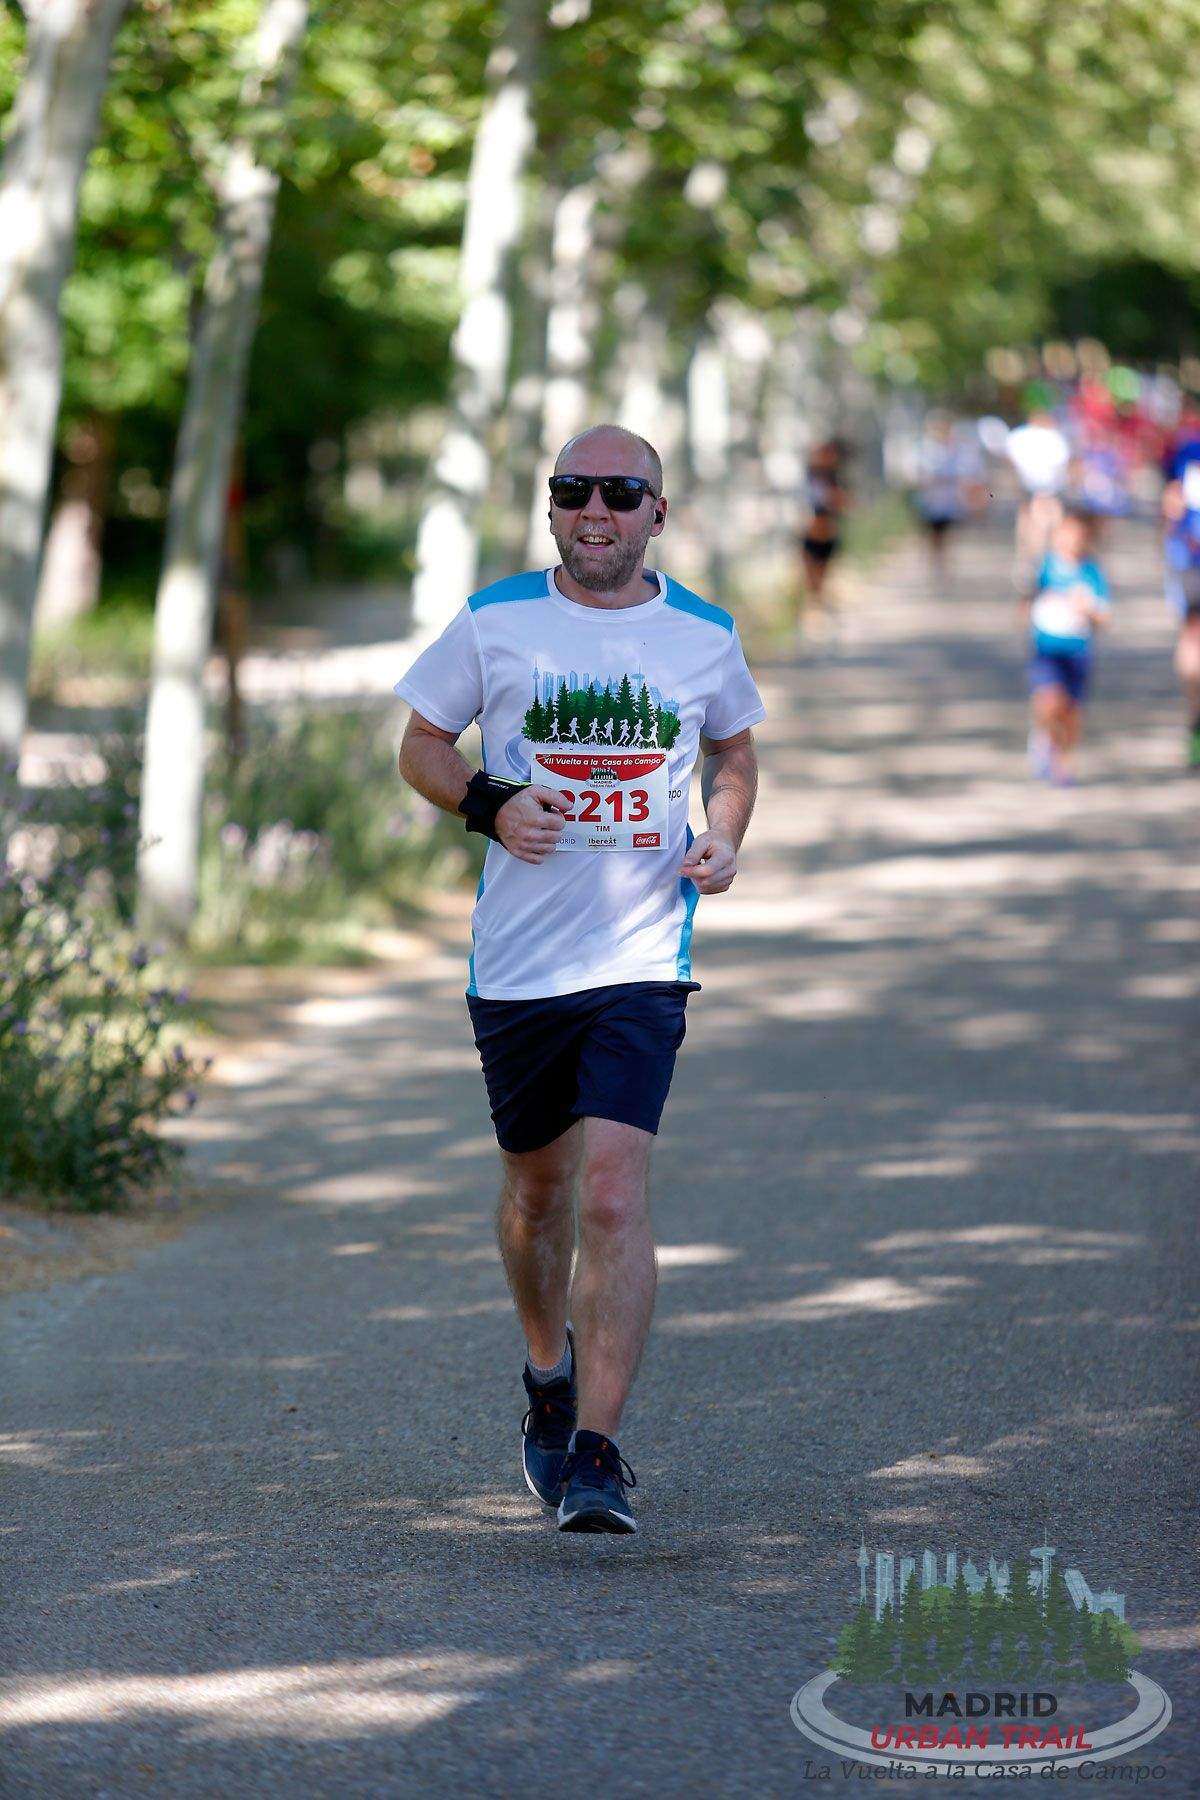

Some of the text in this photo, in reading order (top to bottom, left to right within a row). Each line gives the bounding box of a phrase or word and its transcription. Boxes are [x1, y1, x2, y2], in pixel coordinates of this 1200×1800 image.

[543, 757, 554, 765] XII
[556, 757, 582, 765] Vuelta
[590, 758, 598, 766] la
[602, 758, 622, 766] Casa
[623, 758, 633, 766] de
[634, 757, 661, 766] Campo
